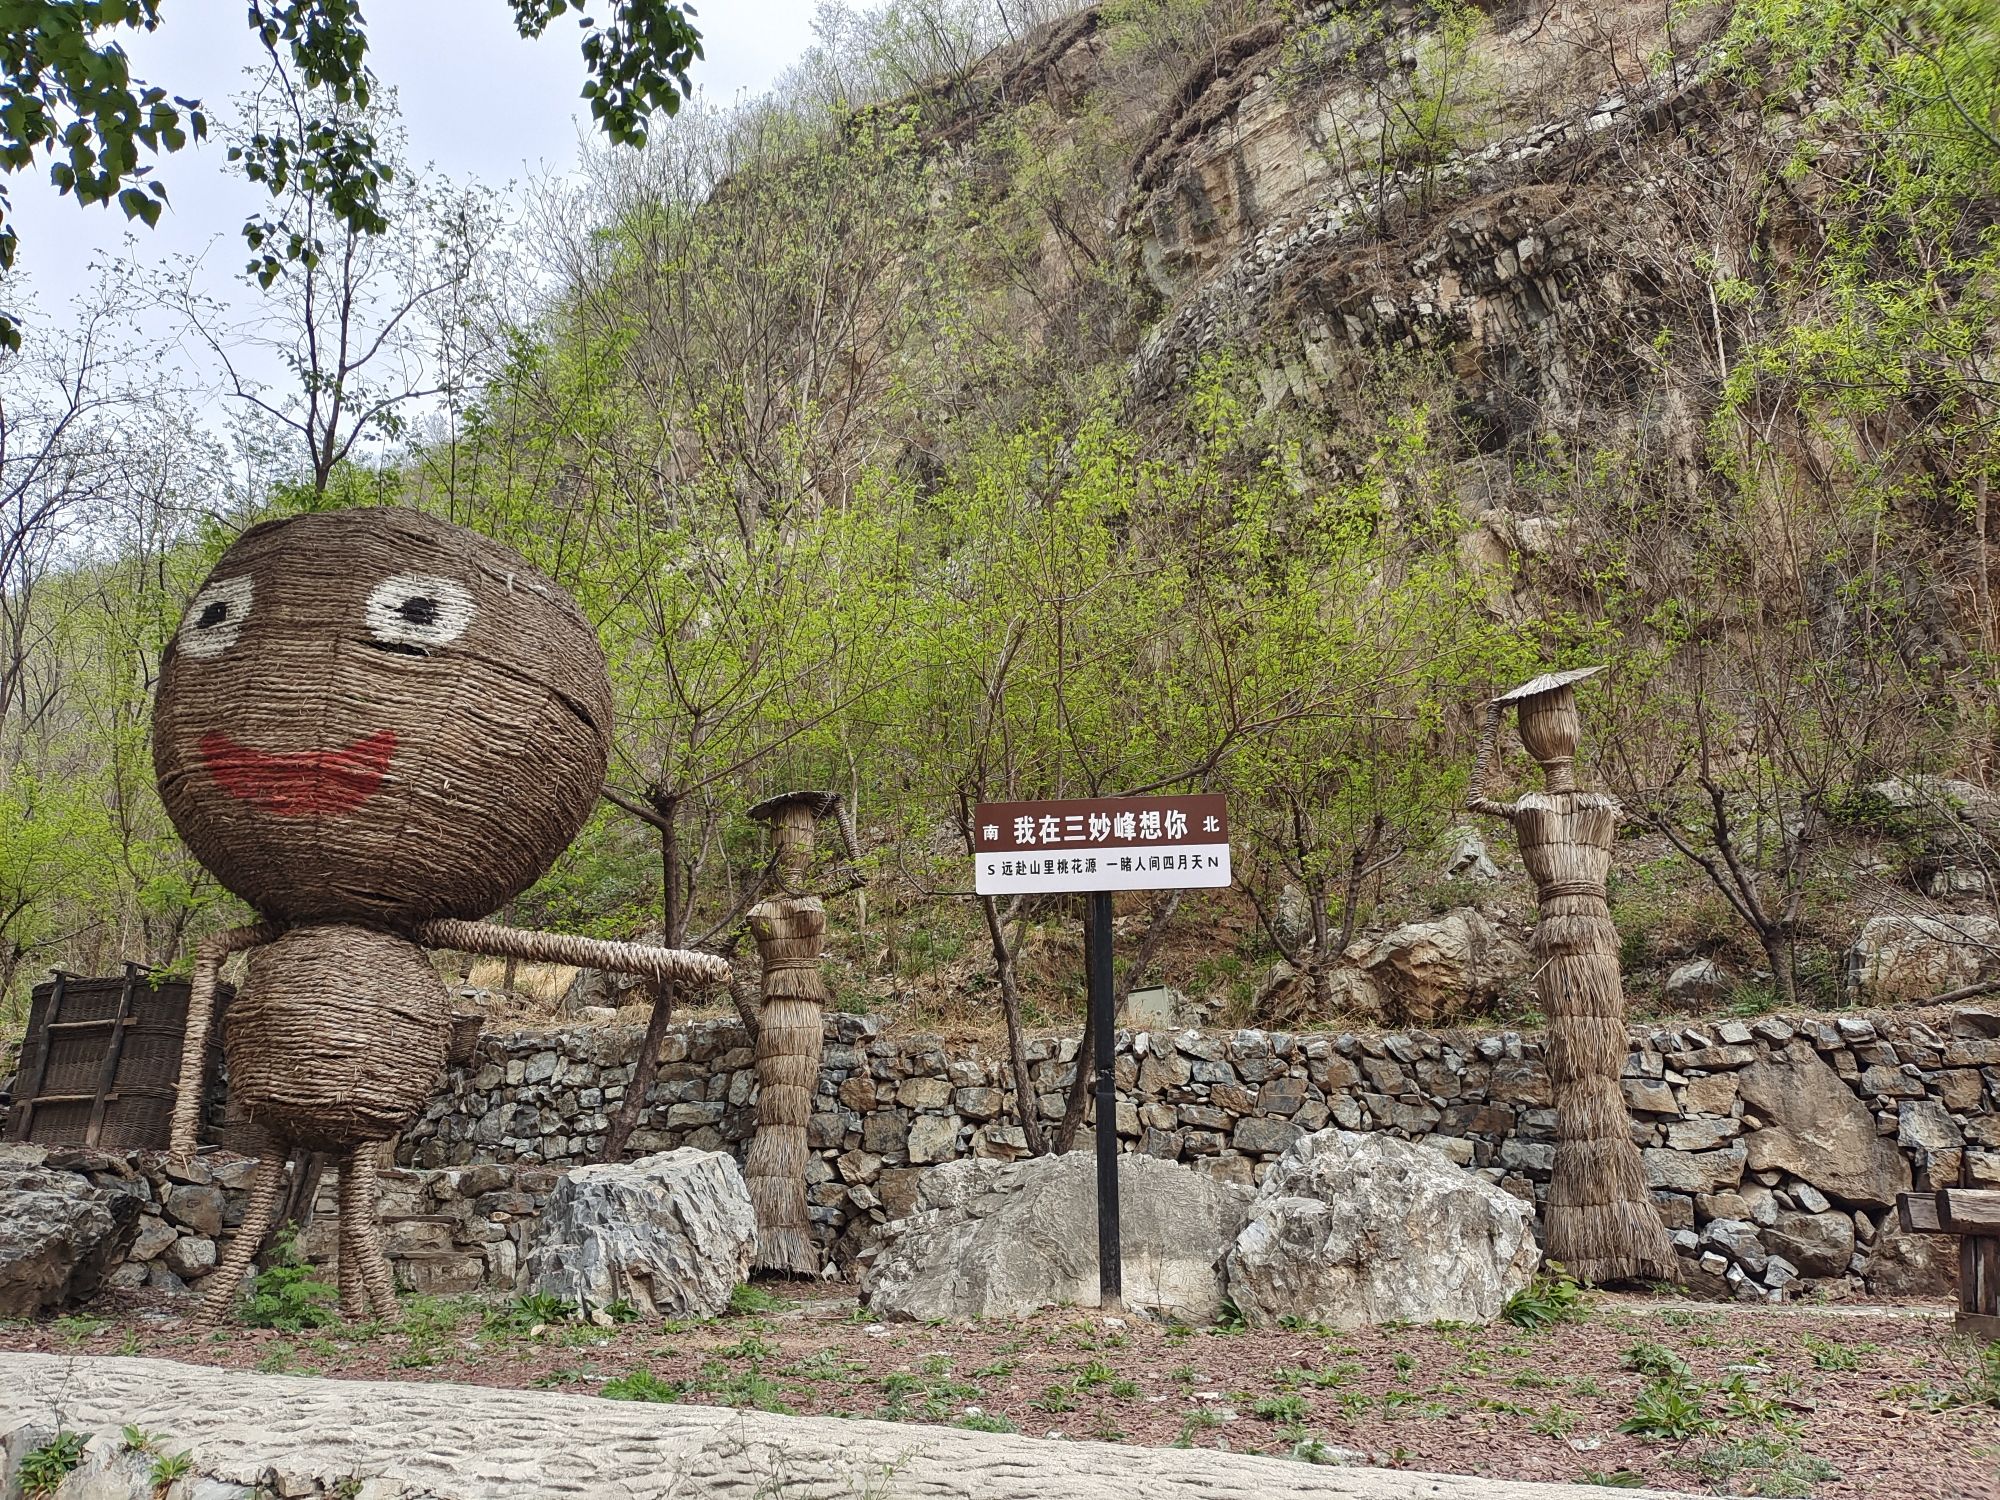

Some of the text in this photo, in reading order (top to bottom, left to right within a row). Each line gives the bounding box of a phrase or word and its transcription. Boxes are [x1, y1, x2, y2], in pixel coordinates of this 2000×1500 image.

[983, 824, 1000, 841] 南
[1013, 810, 1188, 845] 我在三妙峰想你
[1203, 815, 1220, 833] 北
[987, 864, 996, 876] S
[1001, 854, 1203, 876] 远赴山里桃花源 一睹人间四月天
[1208, 856, 1219, 868] N
